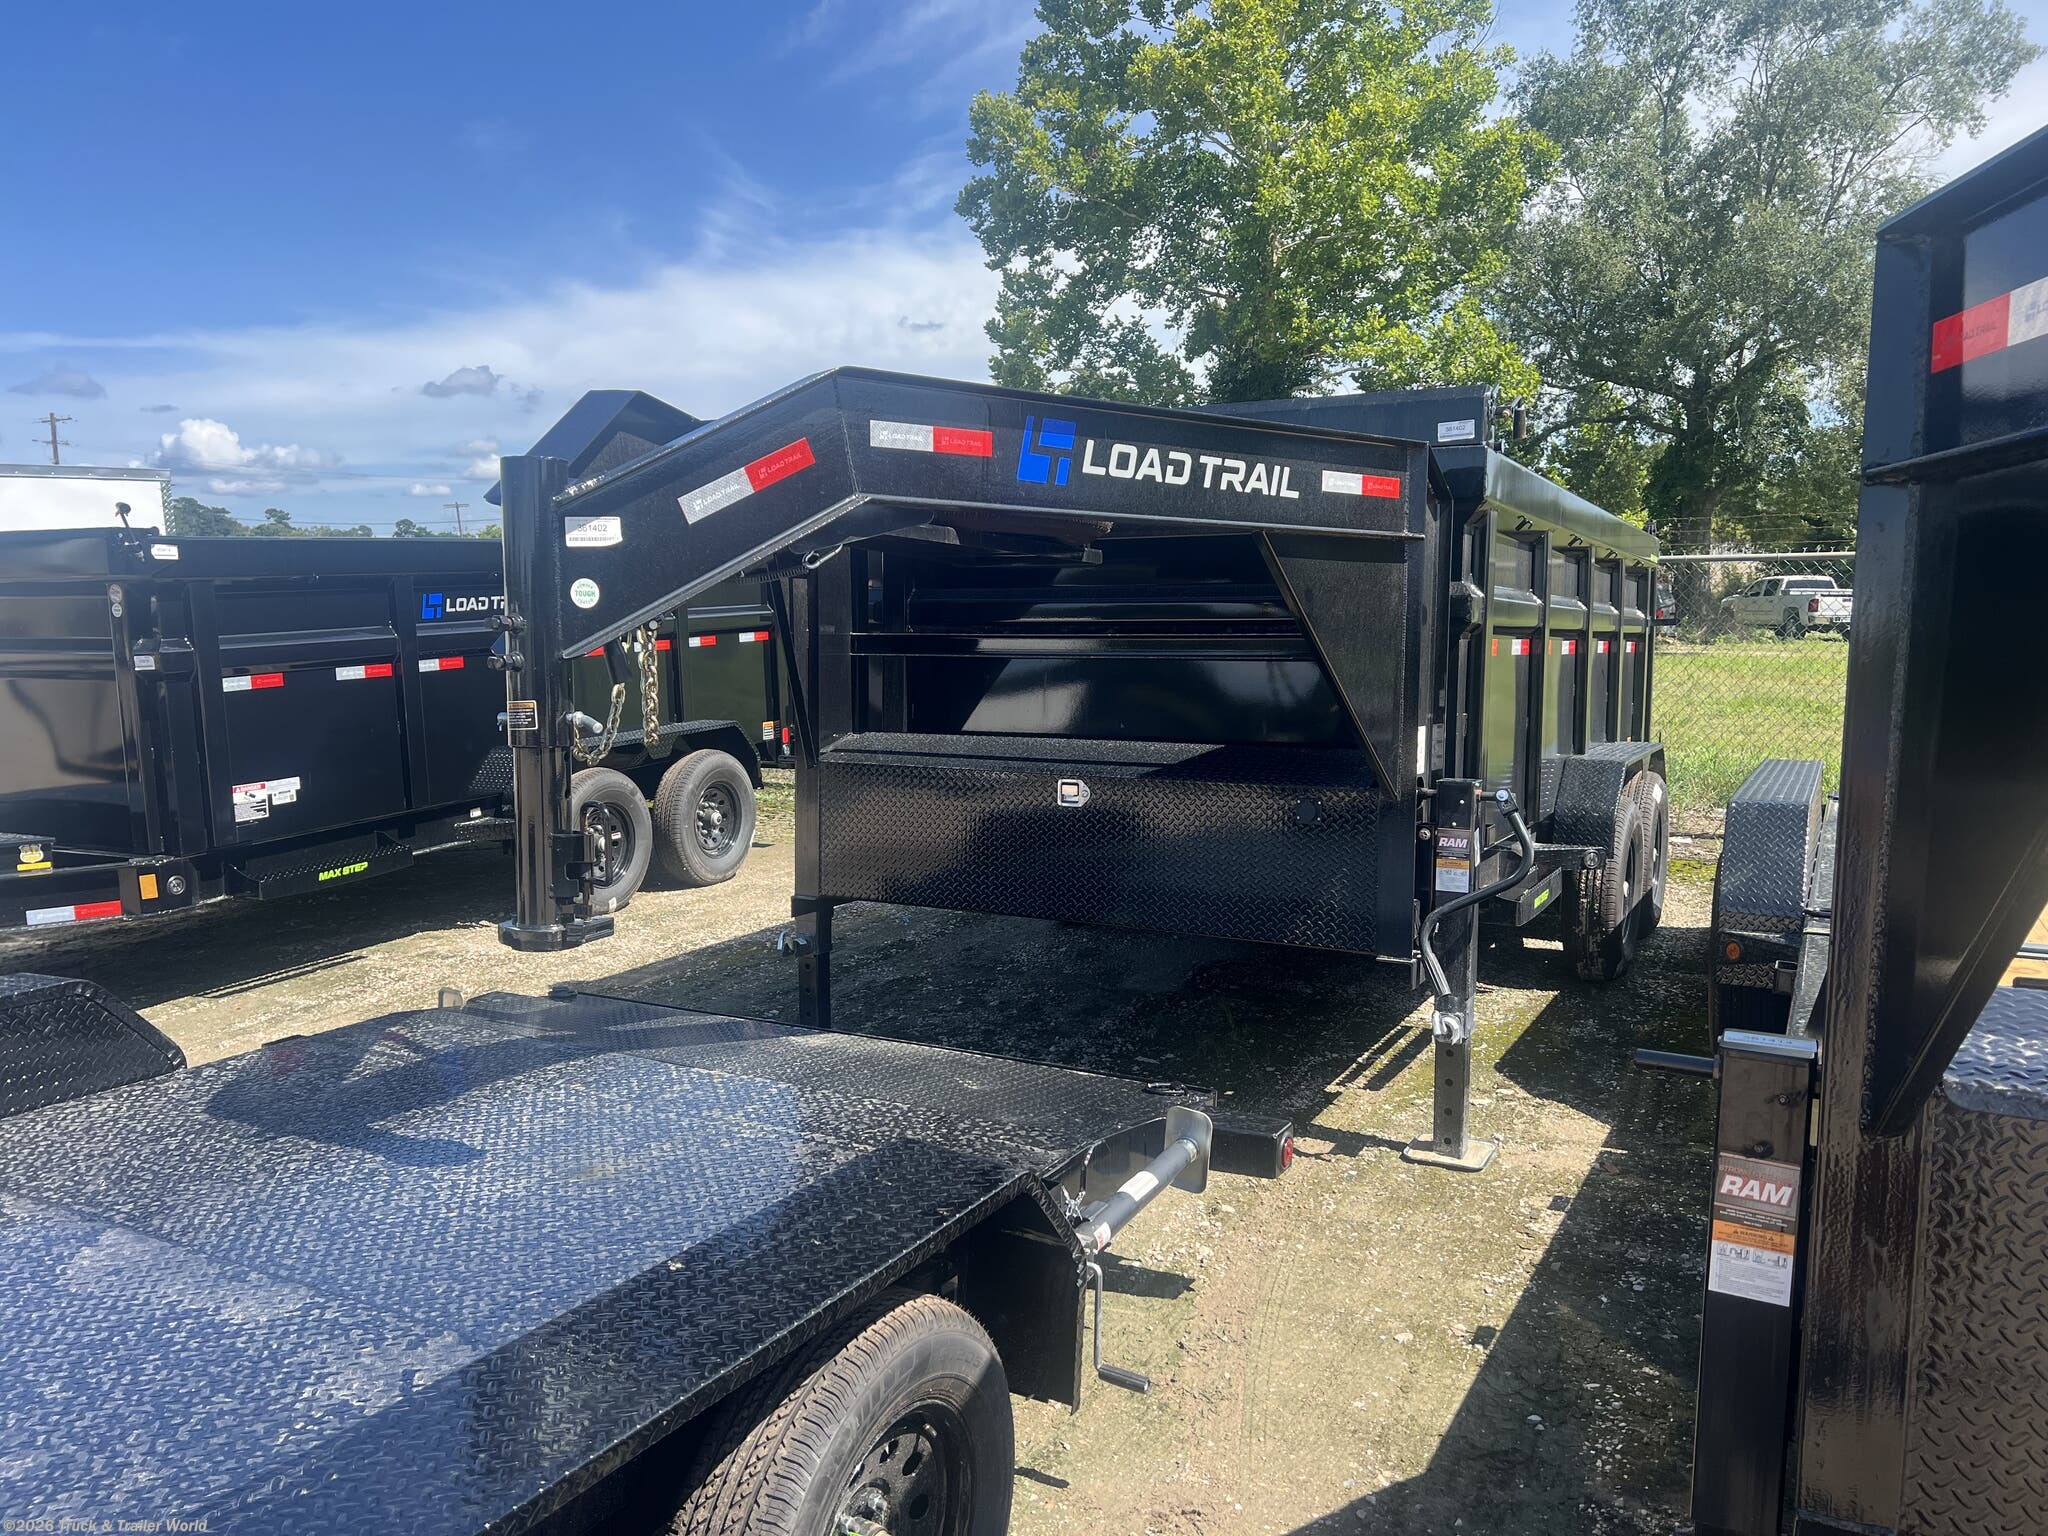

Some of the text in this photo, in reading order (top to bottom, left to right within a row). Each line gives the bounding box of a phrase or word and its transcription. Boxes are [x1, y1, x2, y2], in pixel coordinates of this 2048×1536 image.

[1082, 439, 1299, 499] LOAD TRAIL
[577, 523, 608, 533] 361402
[575, 590, 596, 598] TOUGH
[446, 597, 489, 612] LOAD
[1438, 837, 1468, 849] RAM
[318, 861, 369, 881] MAX STEP
[1720, 1174, 1793, 1206] RAM
